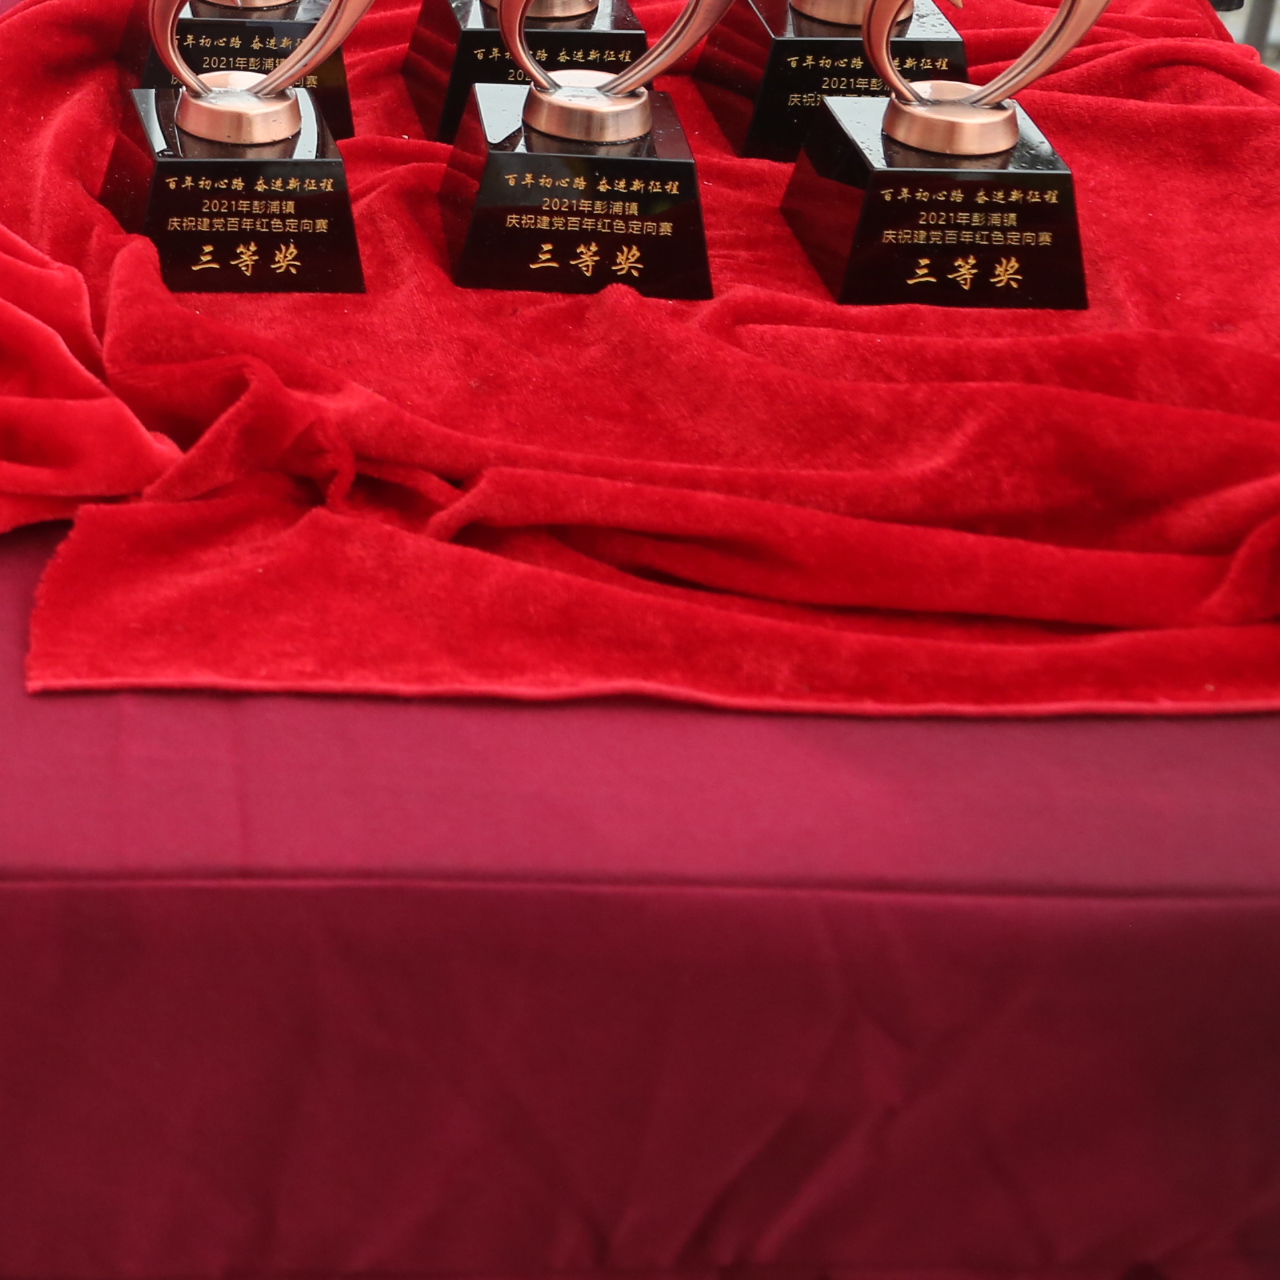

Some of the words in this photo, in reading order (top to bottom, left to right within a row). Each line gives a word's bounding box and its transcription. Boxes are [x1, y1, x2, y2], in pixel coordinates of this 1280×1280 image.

[250, 35, 306, 50] 奋进新
[474, 47, 548, 61] 百年路
[556, 48, 632, 63] 奋进新征程
[787, 55, 864, 70] 百年初心路
[165, 177, 245, 191] 百年初心路
[254, 177, 335, 192] 奋进新征程
[504, 174, 587, 190] 百年初心路
[597, 177, 680, 194] 奋进新征程
[880, 189, 966, 203] 百年初心路
[975, 190, 1059, 204] 奋进新征程
[202, 200, 295, 214] 2021年彭浦镇
[542, 197, 639, 216] 2021年彭浦镇
[167, 217, 328, 233] 庆祝建党百年红色定向赛
[506, 215, 673, 236] 庆祝建党百年红色定向赛
[919, 211, 1017, 227] 2021年彭浦镇
[883, 230, 1053, 246] 庆祝建党百年红色定向赛
[191, 243, 302, 276] 三等奖
[530, 243, 644, 277] 三等奖
[906, 256, 1023, 290] 三等奖
